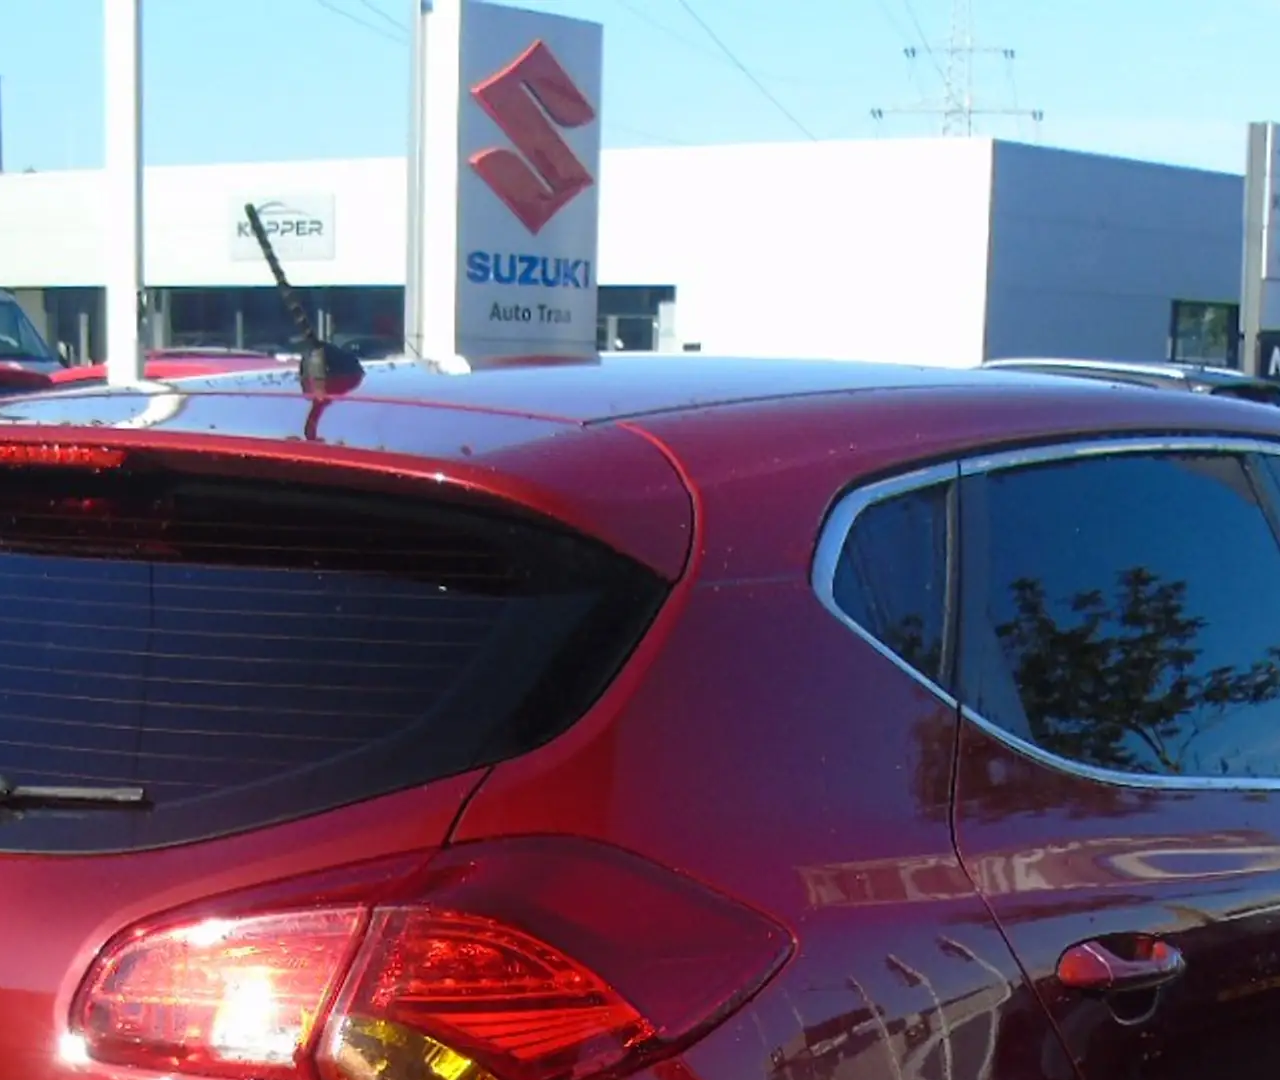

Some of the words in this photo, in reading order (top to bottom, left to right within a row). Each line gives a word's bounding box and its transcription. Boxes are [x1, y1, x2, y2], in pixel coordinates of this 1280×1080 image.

[237, 220, 324, 237] KPPER
[466, 250, 590, 288] SUZUKI
[489, 302, 532, 321] Auto
